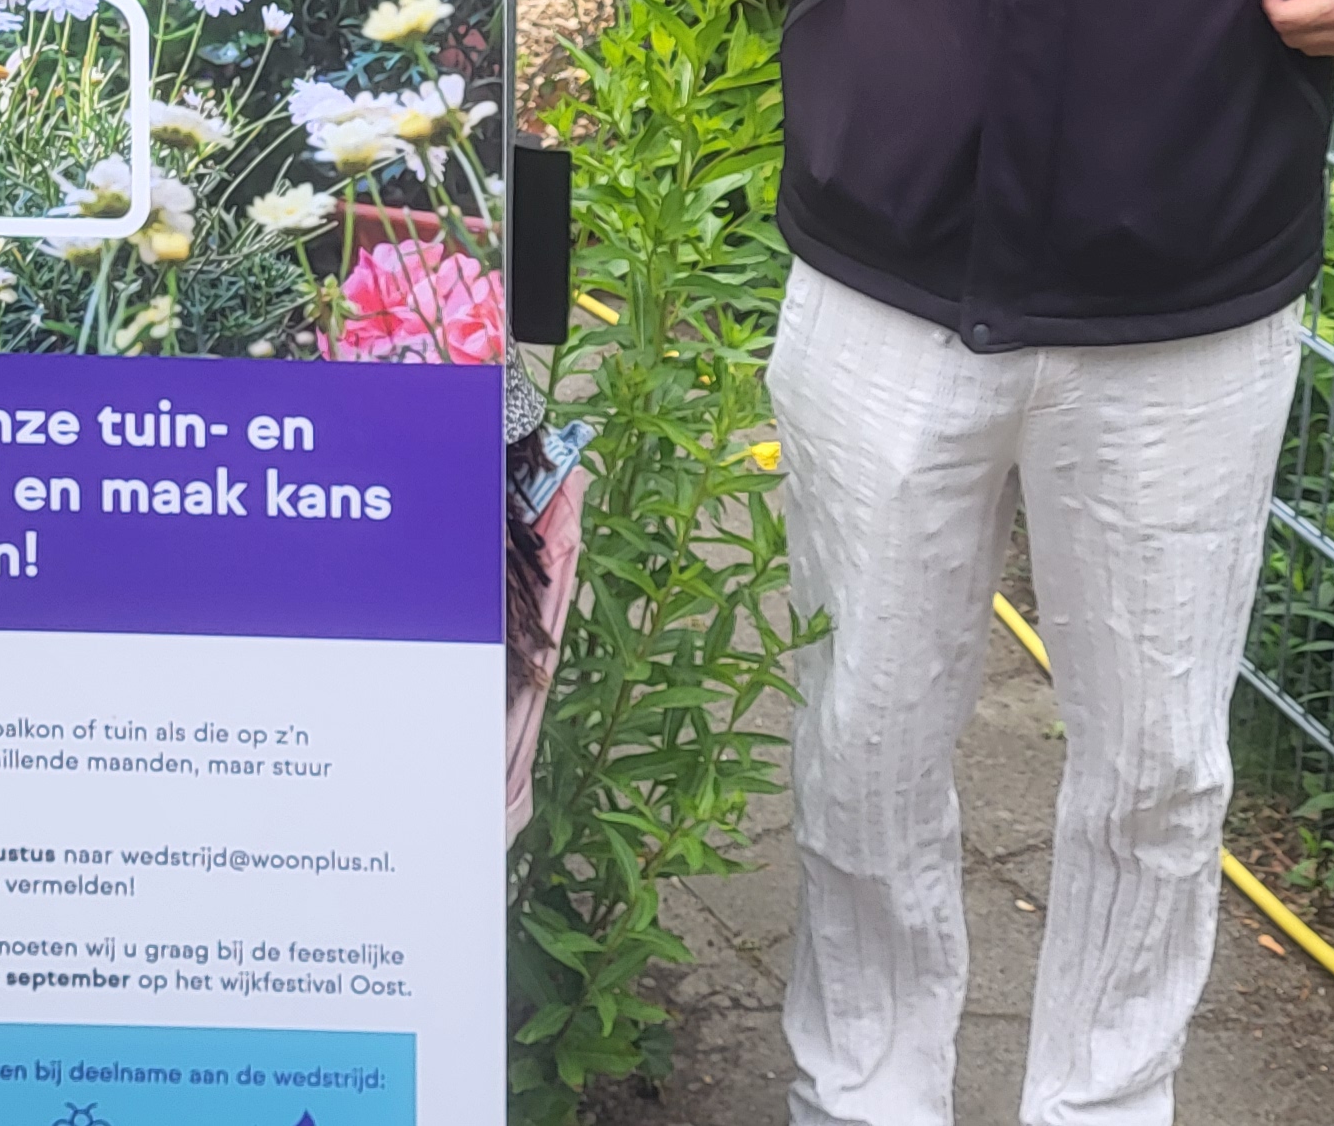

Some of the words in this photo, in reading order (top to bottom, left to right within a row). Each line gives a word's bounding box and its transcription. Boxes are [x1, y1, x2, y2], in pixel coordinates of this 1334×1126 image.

[97, 399, 228, 448] tuin-
[247, 415, 314, 451] en
[14, 476, 81, 512] en
[101, 466, 248, 516] maak
[266, 468, 392, 520] kans
[72, 718, 97, 740] of
[104, 720, 147, 741] tuin
[156, 721, 186, 742] als
[193, 722, 229, 743] die
[237, 728, 268, 749] op
[276, 725, 309, 745] z'n
[87, 751, 199, 777] maanden,
[208, 759, 265, 776] maar
[272, 760, 333, 777] stuur
[64, 849, 113, 864] naar
[120, 845, 395, 875] wedstrijd@woonplus.nl.
[5, 874, 135, 897] vermelden!
[85, 937, 116, 963] wij
[123, 943, 137, 958] u
[144, 944, 209, 965] graag
[217, 939, 244, 966] bij
[251, 941, 281, 962] de
[288, 941, 405, 970] feestelijke
[6, 969, 131, 992] september
[138, 974, 168, 994] op
[176, 971, 211, 991] het
[220, 972, 342, 997] wijkfestival
[350, 975, 412, 996] Oost.
[34, 1059, 62, 1087] bij
[68, 1060, 183, 1084] deelname
[189, 1069, 229, 1085] aan
[237, 1064, 266, 1086] de
[273, 1066, 385, 1093] wedstrijd:
